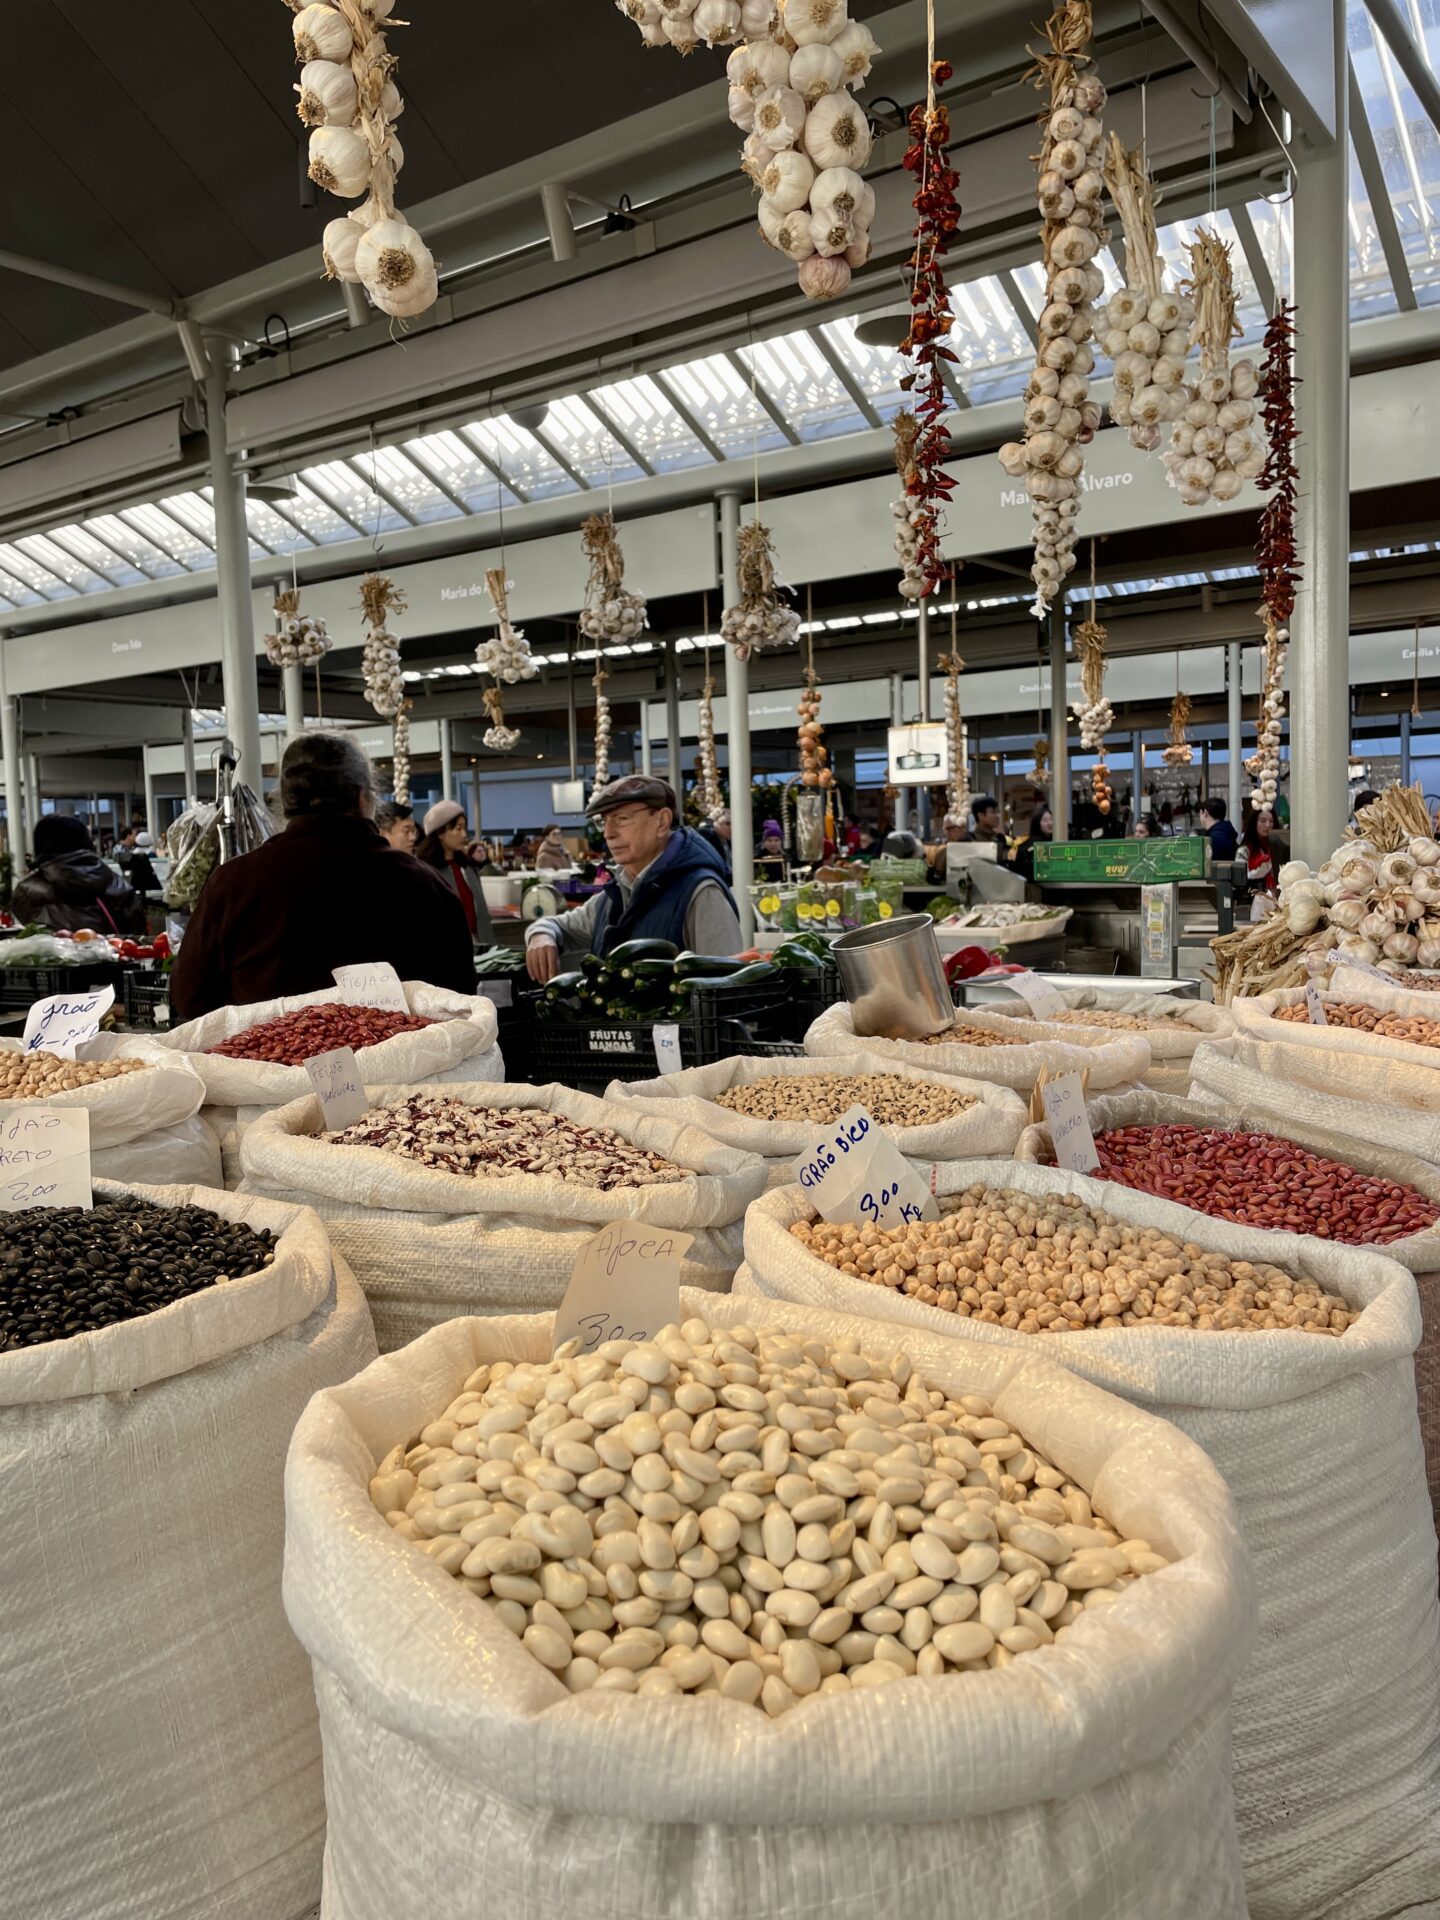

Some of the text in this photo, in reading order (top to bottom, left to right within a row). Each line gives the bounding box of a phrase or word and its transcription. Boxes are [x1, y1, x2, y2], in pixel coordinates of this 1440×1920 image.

[1080, 471, 1133, 493] Álvaro
[1105, 865, 1129, 874] RUBY
[589, 1030, 632, 1040] FRUTAS
